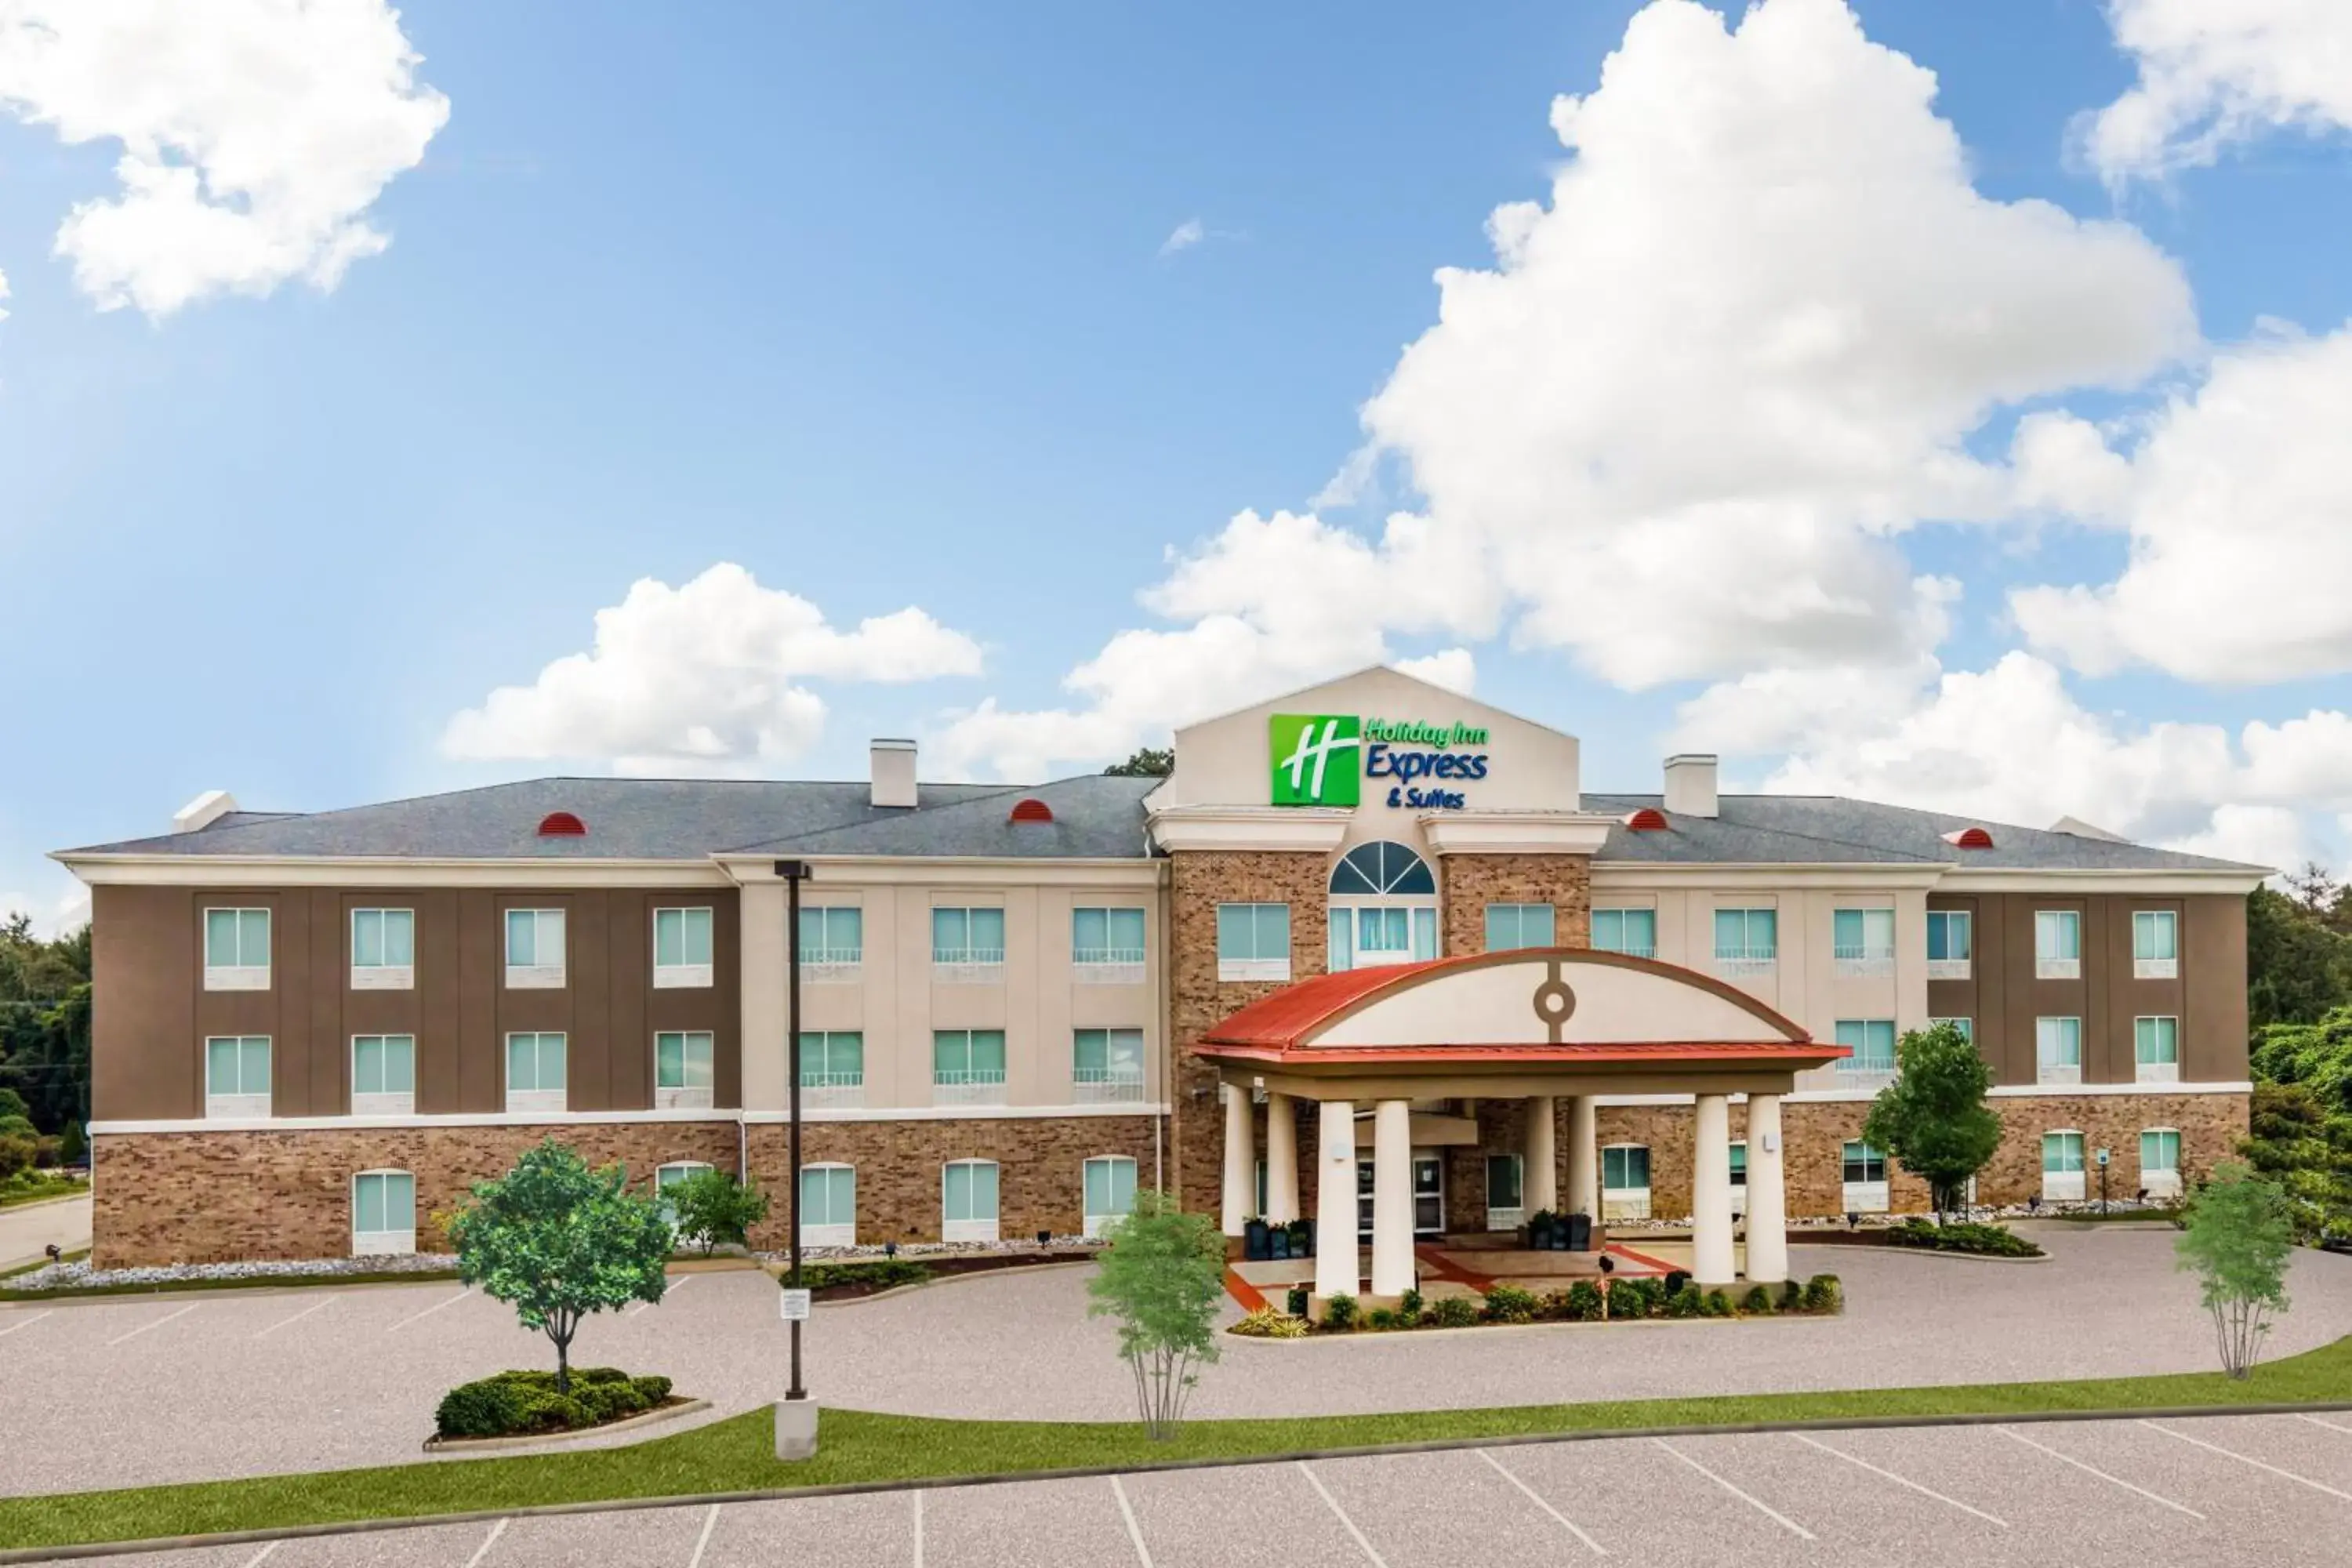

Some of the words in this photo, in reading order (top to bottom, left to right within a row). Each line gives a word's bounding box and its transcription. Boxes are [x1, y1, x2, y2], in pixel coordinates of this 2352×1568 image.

[1365, 719, 1450, 750] Holiday
[1454, 720, 1489, 745] Inn
[1367, 744, 1488, 784] Express
[1387, 787, 1401, 808] &
[1405, 787, 1465, 808] Suites
